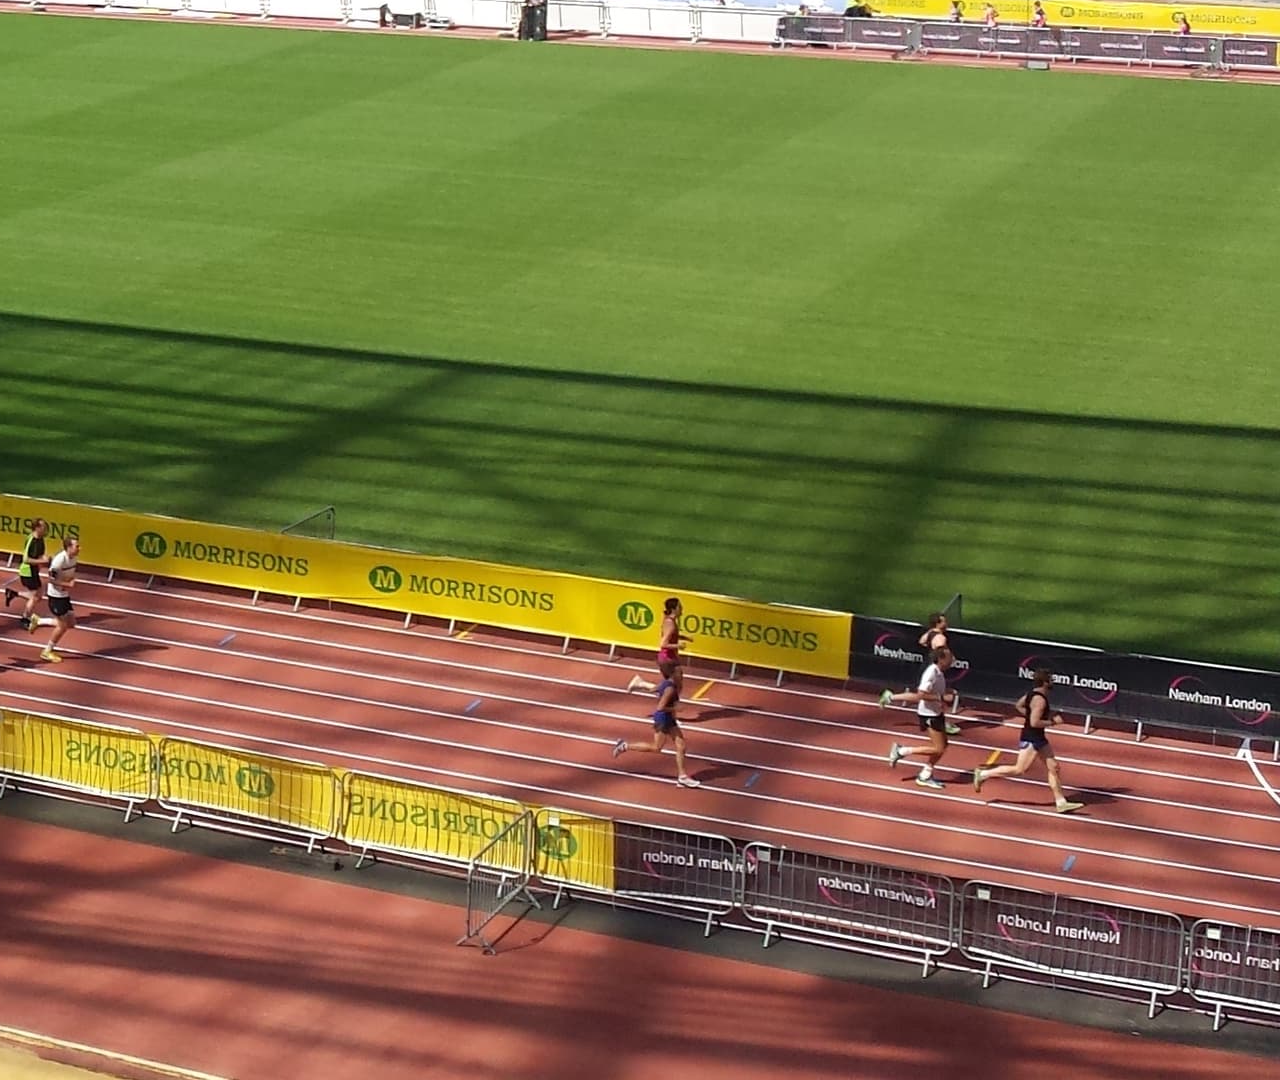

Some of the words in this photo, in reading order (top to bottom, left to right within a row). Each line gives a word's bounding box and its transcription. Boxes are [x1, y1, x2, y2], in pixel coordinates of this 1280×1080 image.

[173, 540, 309, 576] MORRISONS
[408, 574, 554, 612] MORRISONS
[874, 643, 923, 663] Newham
[1073, 674, 1117, 693] London
[1169, 687, 1222, 707] Newham
[1225, 693, 1271, 713] London
